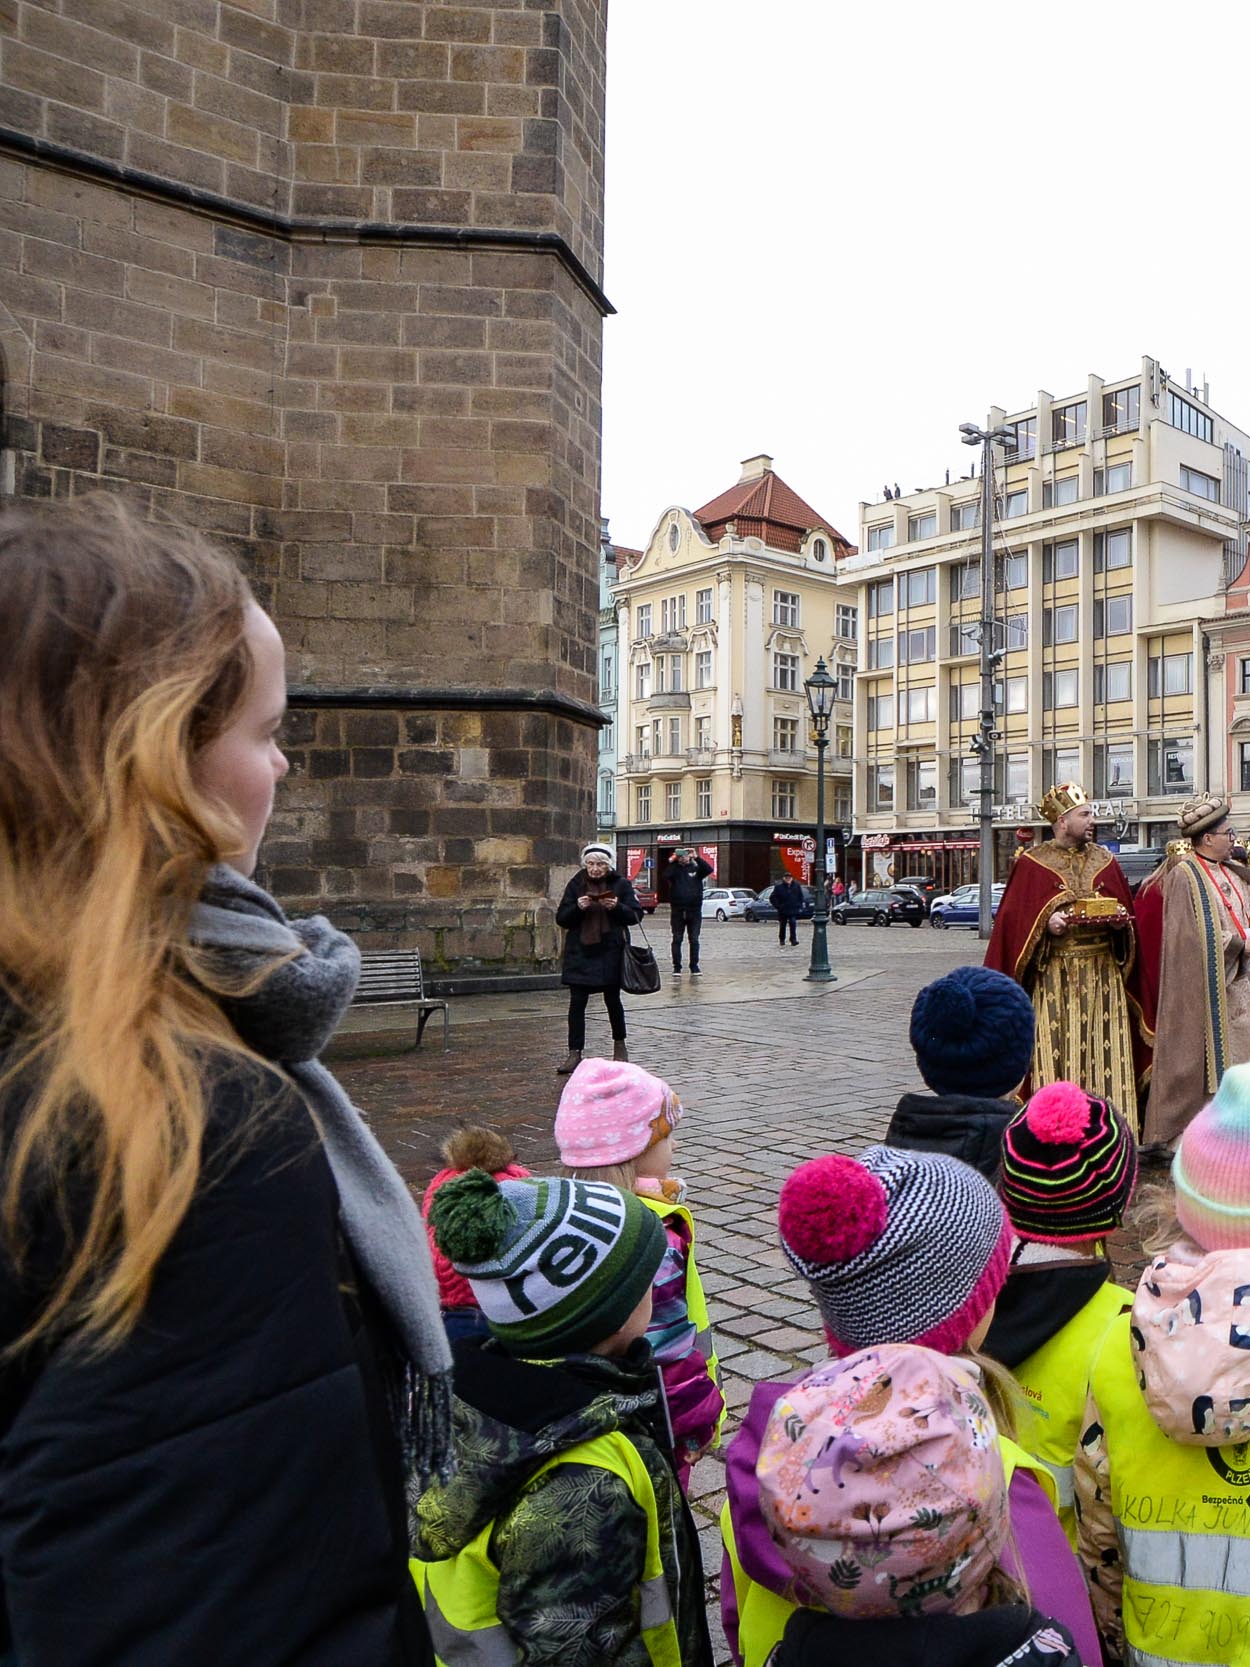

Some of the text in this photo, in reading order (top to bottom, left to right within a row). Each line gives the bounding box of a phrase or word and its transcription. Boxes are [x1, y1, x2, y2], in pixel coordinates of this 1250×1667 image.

[971, 804, 1027, 823] HTEL
[1202, 1495, 1244, 1507] Bezpečná
[1137, 1595, 1186, 1641] 727
